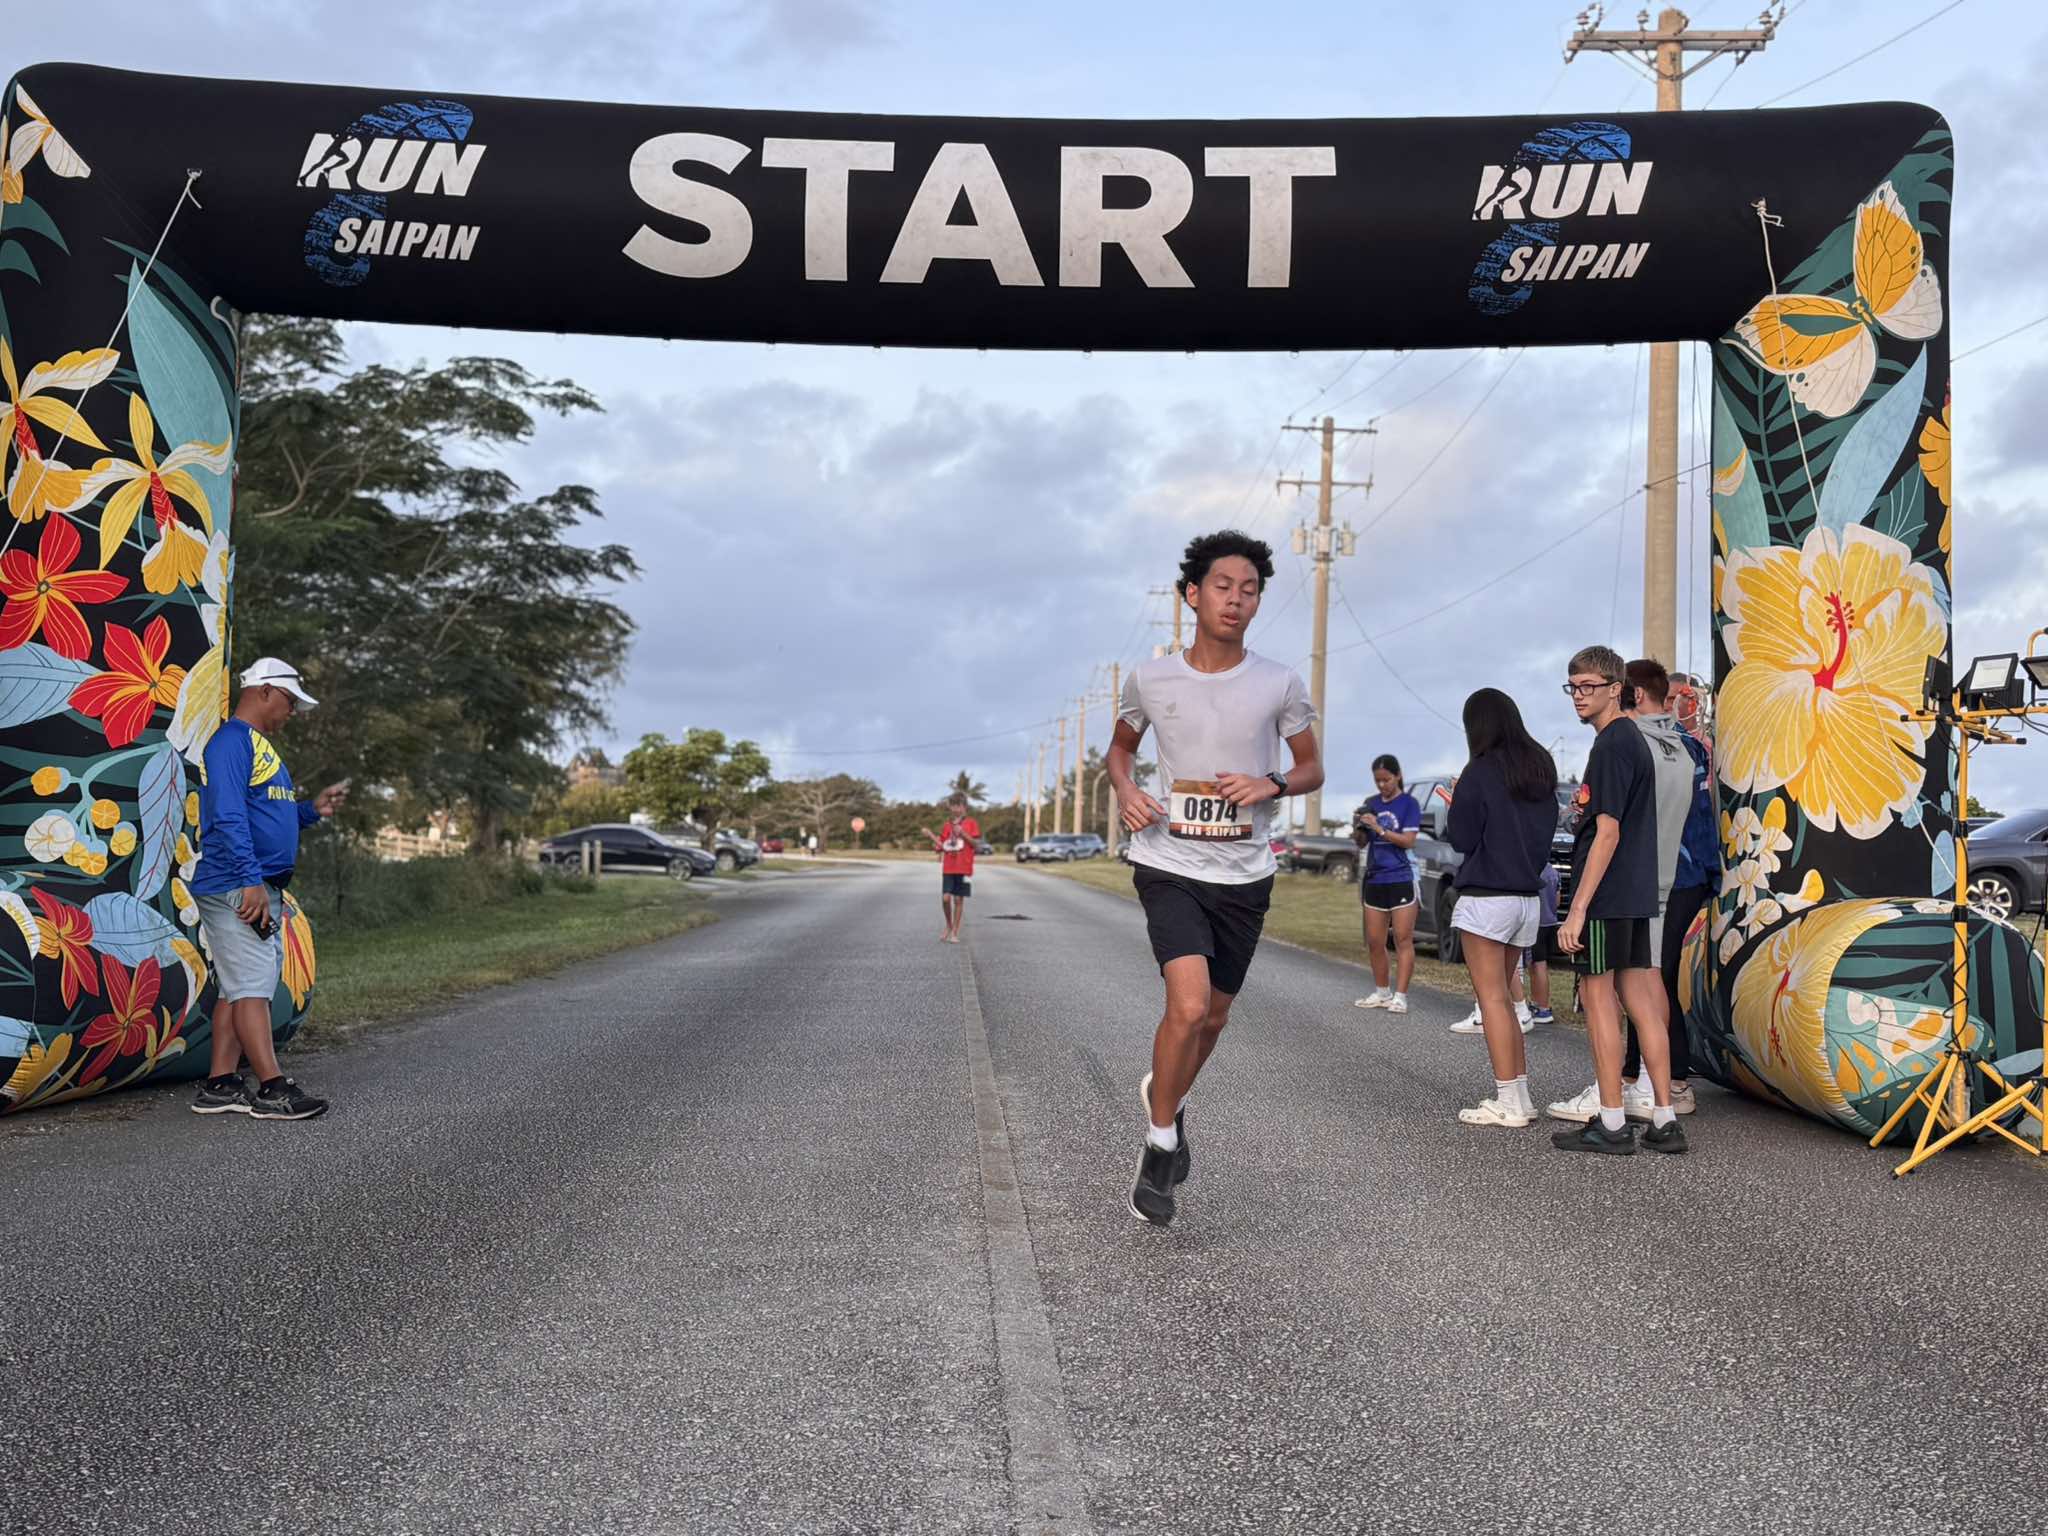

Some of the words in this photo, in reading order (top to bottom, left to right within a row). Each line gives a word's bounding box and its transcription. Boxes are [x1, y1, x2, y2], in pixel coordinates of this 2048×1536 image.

[297, 132, 487, 197] RUN
[622, 132, 1337, 288] START
[1472, 161, 1654, 220] RUN
[334, 217, 481, 261] SAIPAN
[1501, 242, 1651, 282] SAIPAN
[1180, 825, 1202, 835] RUN
[1205, 826, 1241, 837] SAIPAN
[1184, 797, 1237, 823] 0874
